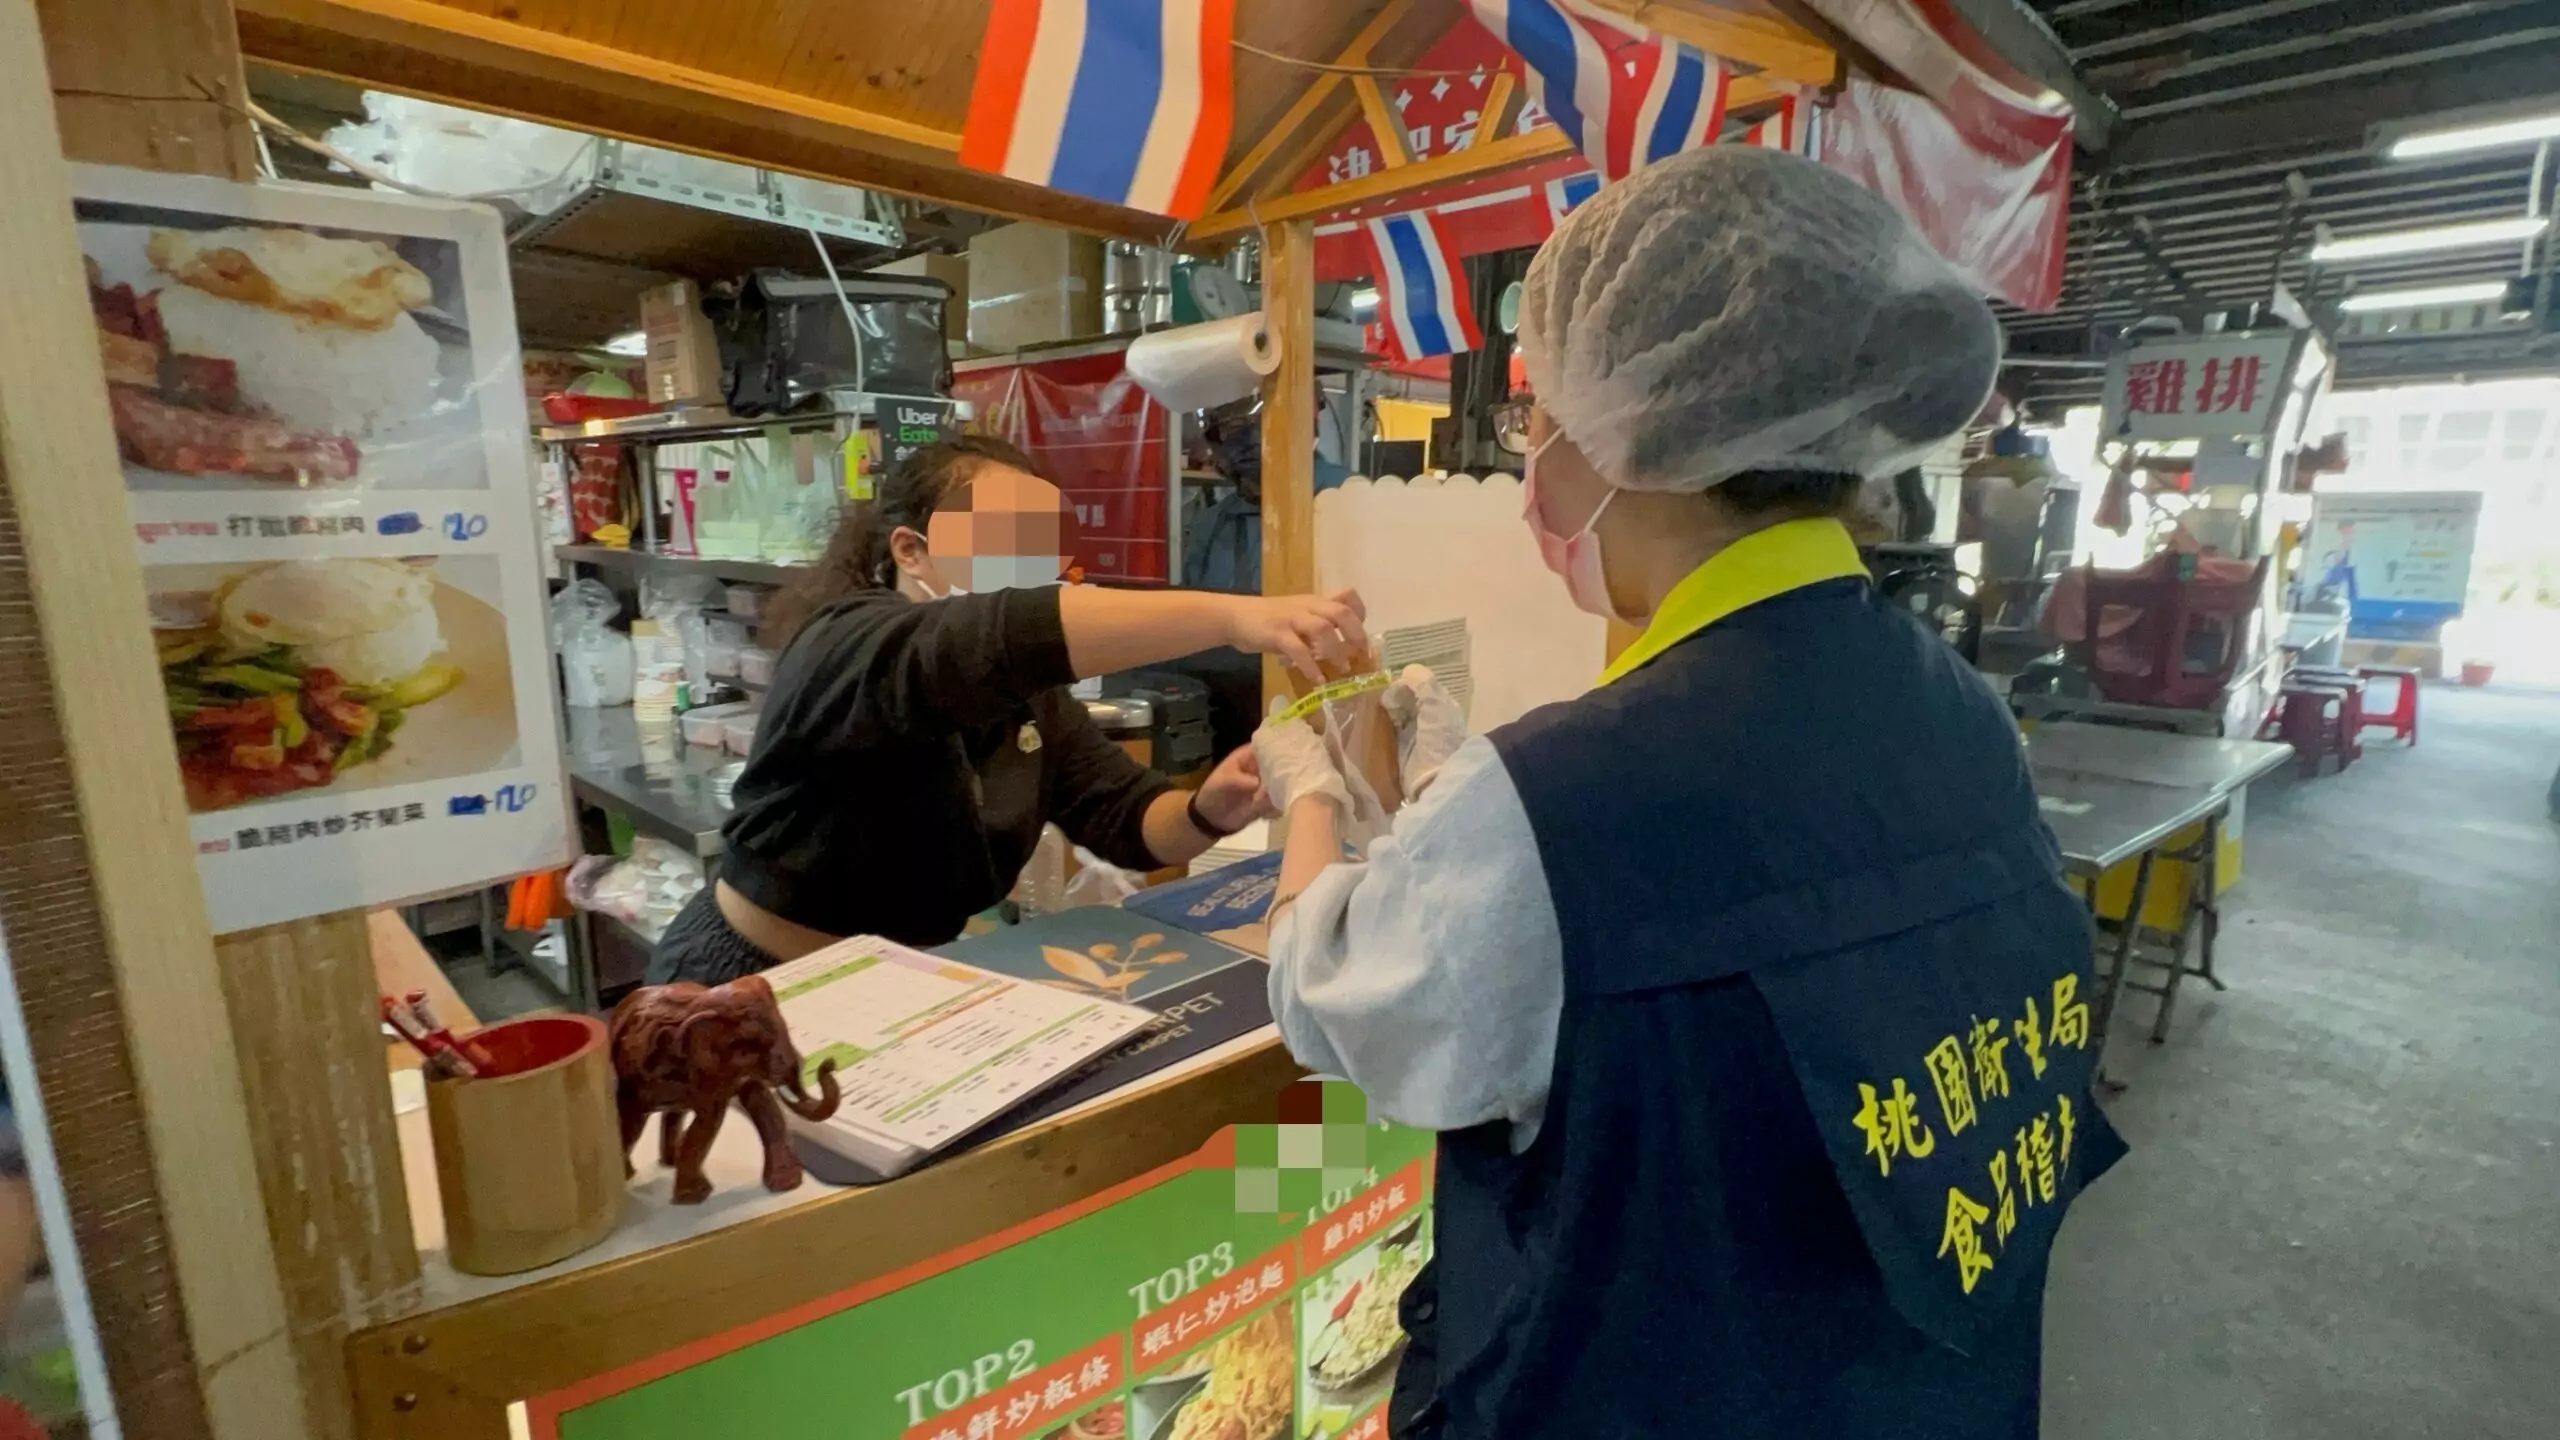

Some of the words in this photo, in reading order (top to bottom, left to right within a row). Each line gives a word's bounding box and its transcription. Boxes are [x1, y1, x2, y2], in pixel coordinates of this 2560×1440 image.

[896, 407, 939, 425] Uber
[2126, 354, 2271, 415] 雞排
[899, 425, 939, 443] Eats
[1852, 972, 2090, 1178] 桃園衛生局
[1127, 1241, 1236, 1320] TOP3
[895, 1338, 1037, 1428] TOP2
